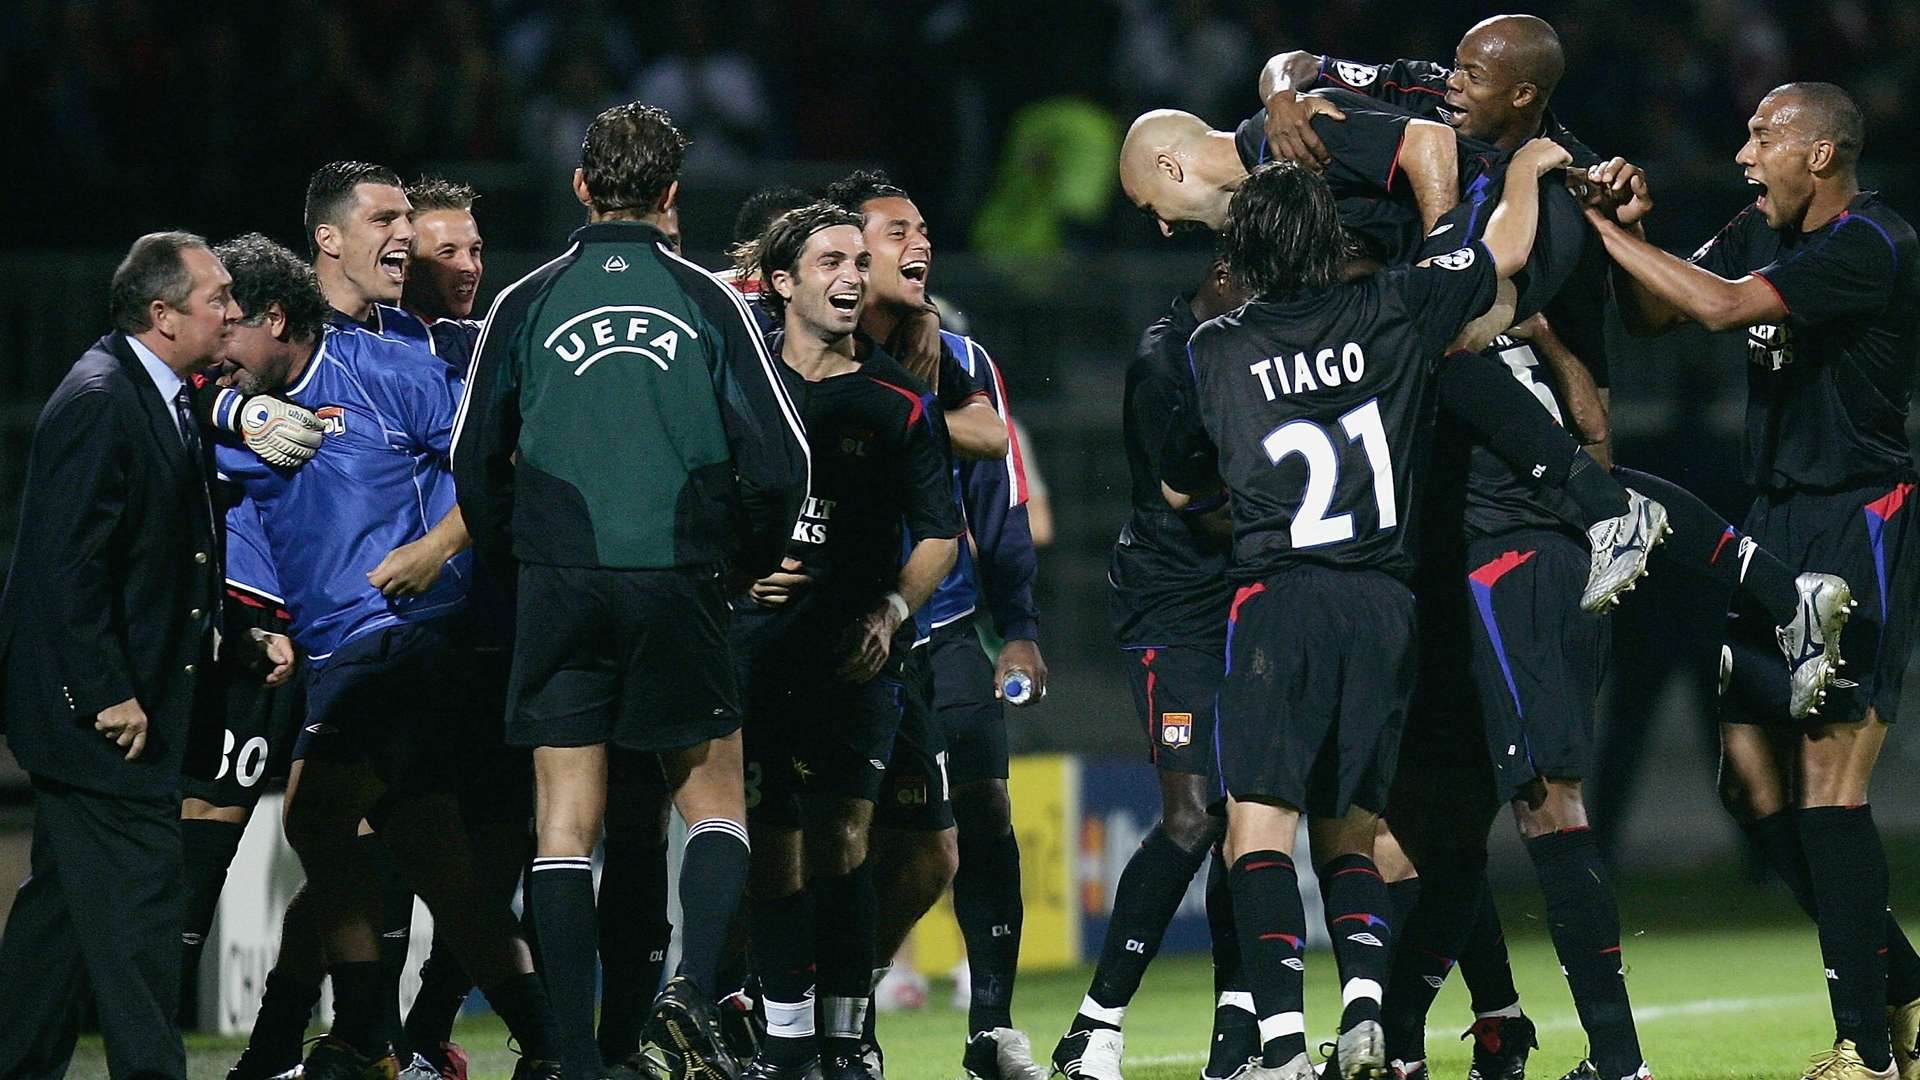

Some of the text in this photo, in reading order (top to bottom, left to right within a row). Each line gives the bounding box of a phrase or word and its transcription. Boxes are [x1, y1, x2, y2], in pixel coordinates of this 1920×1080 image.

[555, 317, 679, 362] UEFA
[1250, 342, 1365, 401] TIAGO
[1261, 397, 1397, 549] 21
[1164, 726, 1188, 743] OL
